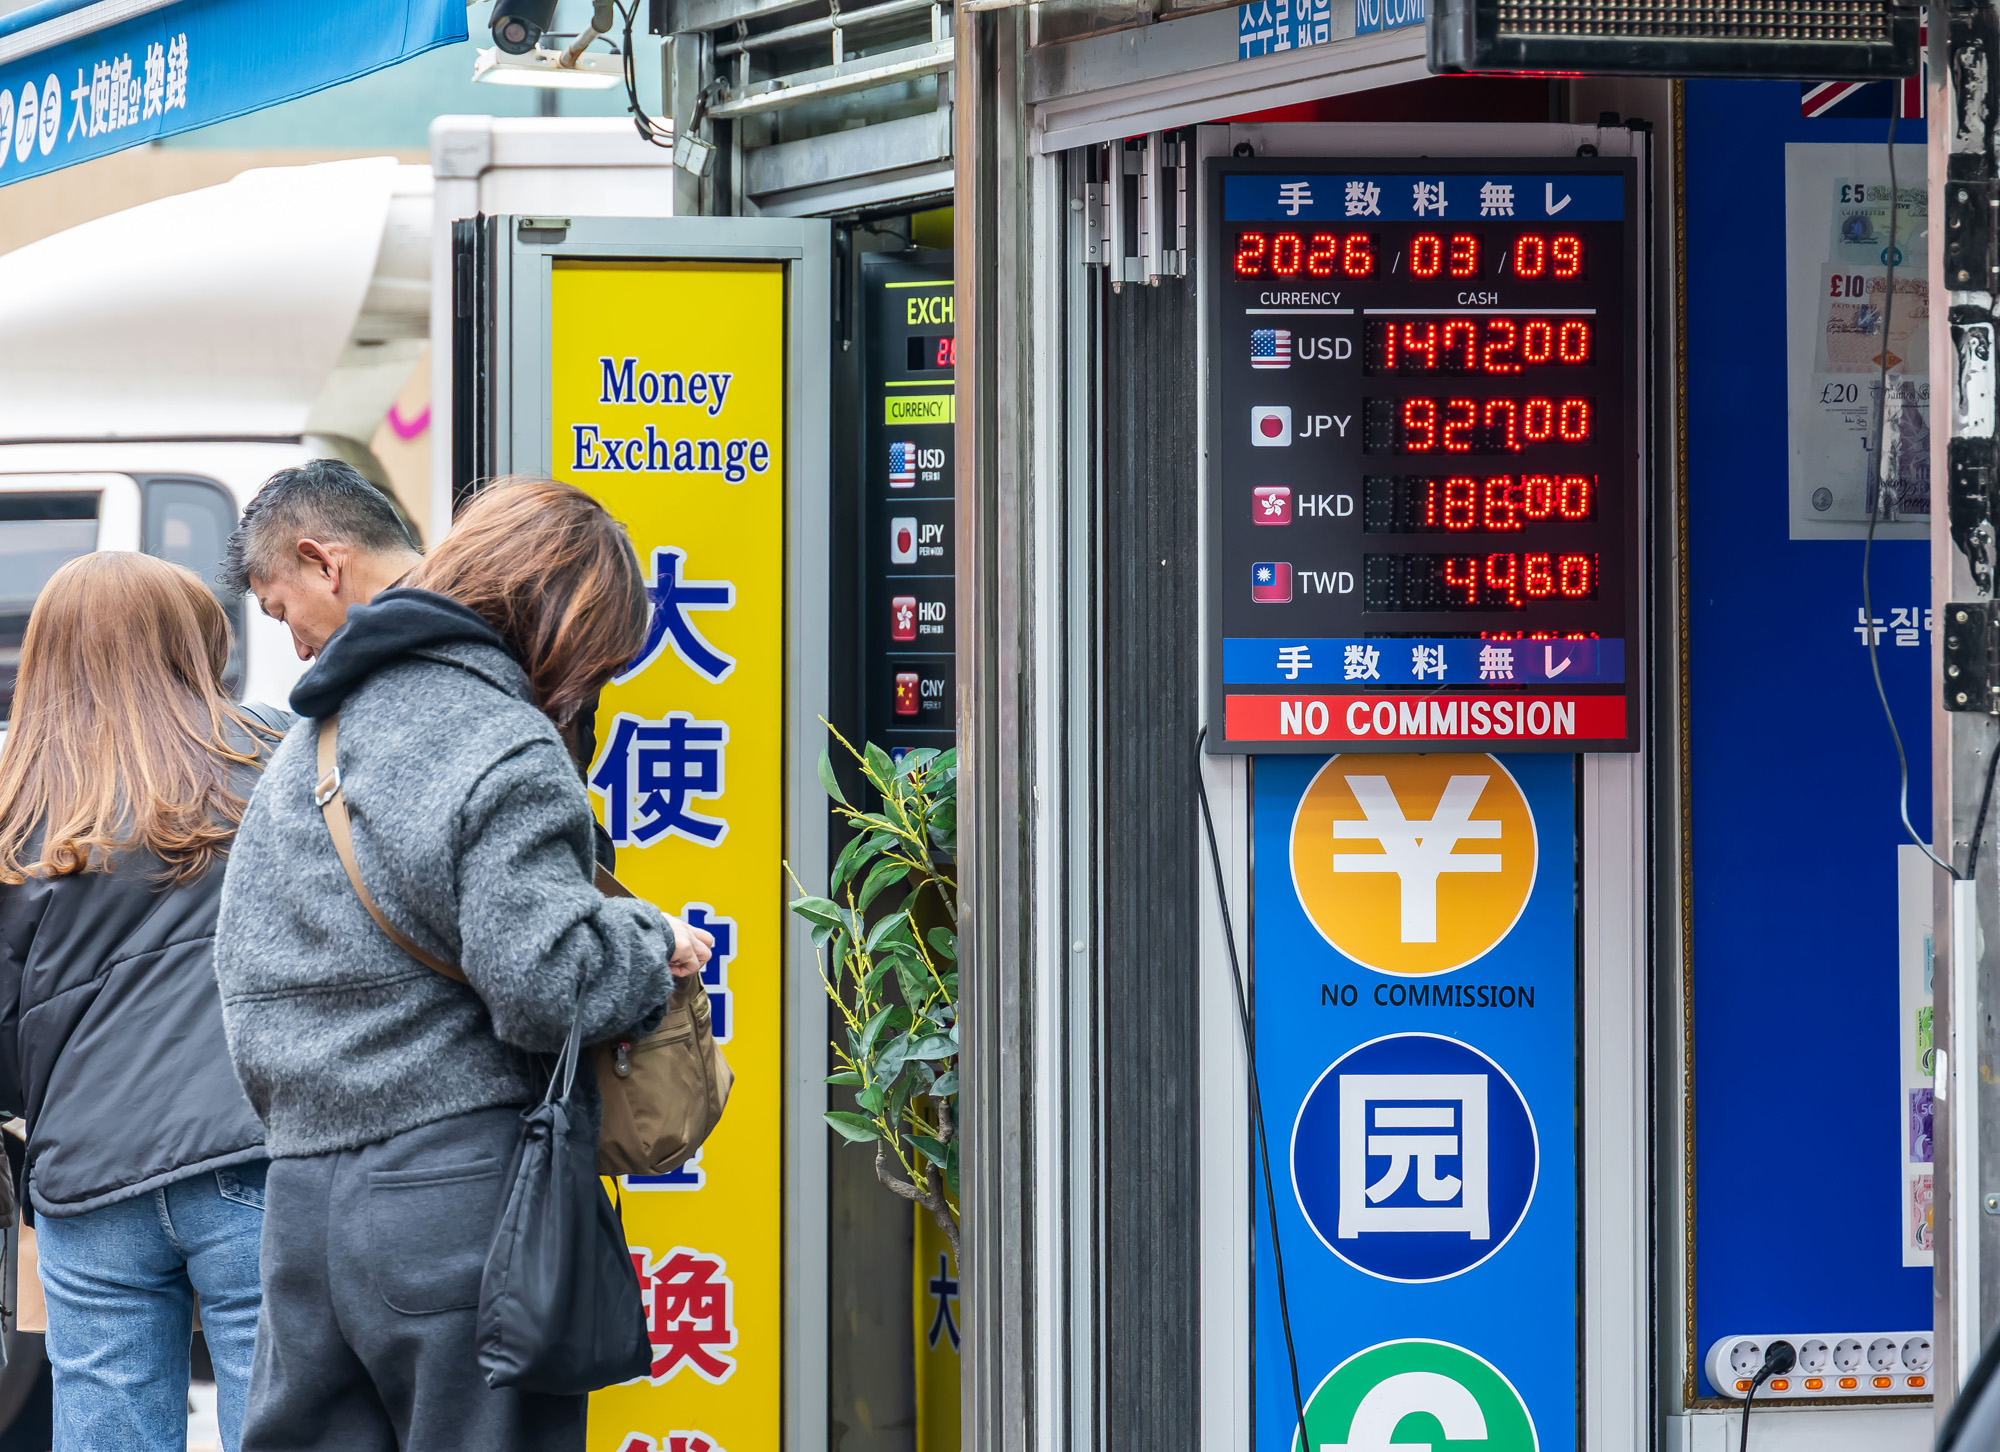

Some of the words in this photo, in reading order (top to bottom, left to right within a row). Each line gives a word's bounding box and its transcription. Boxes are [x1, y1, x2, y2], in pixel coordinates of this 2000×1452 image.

[1385, 0, 1425, 26] COM
[1840, 184, 1865, 204] £5
[1236, 233, 1372, 276] 2026
[1412, 236, 1477, 277] 03
[1516, 236, 1580, 277] 09
[1830, 274, 1864, 298] £10
[907, 296, 955, 325] EXCH
[1260, 292, 1341, 306] CURRENCY
[1457, 292, 1499, 306] CASH
[1298, 337, 1353, 361] USD
[600, 357, 732, 416] Money
[1820, 382, 1858, 404] £20
[892, 401, 943, 418] CURRENCY
[1299, 415, 1352, 438] JPY
[572, 425, 770, 483] Exchange
[917, 449, 946, 469] USD
[1298, 494, 1354, 518] HKD
[918, 524, 945, 544] JPY
[1298, 571, 1354, 595] TWD
[918, 602, 947, 621] HKD
[920, 679, 945, 697] CNY
[1280, 702, 1329, 735] NO
[1346, 701, 1576, 736] COMMISSION
[1321, 984, 1358, 1007] NO
[1373, 983, 1535, 1009] COMMISSION
